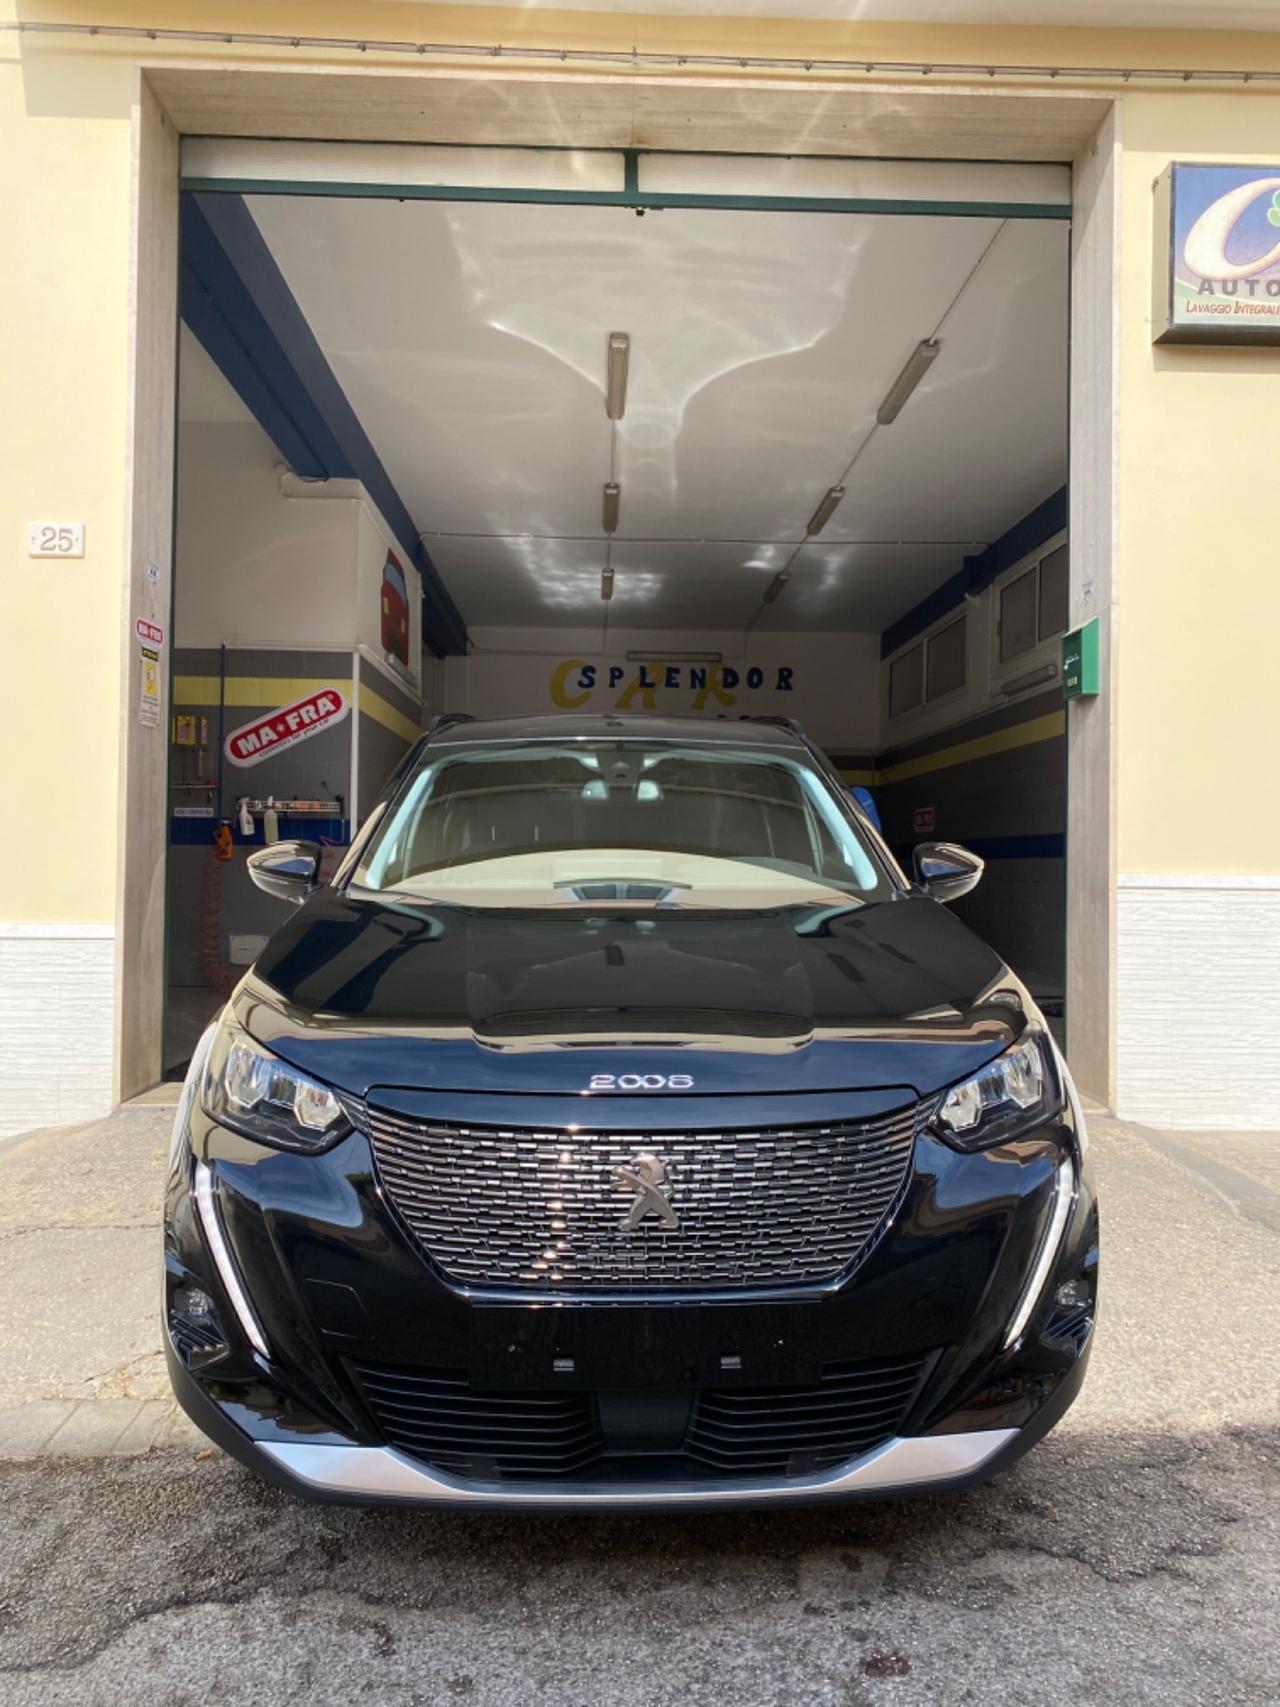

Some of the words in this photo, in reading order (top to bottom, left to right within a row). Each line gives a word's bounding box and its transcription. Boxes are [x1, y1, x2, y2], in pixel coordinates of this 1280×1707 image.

[40, 526, 74, 552] 25
[577, 665, 794, 691] SPLENDOR
[589, 1074, 694, 1089] 2008
